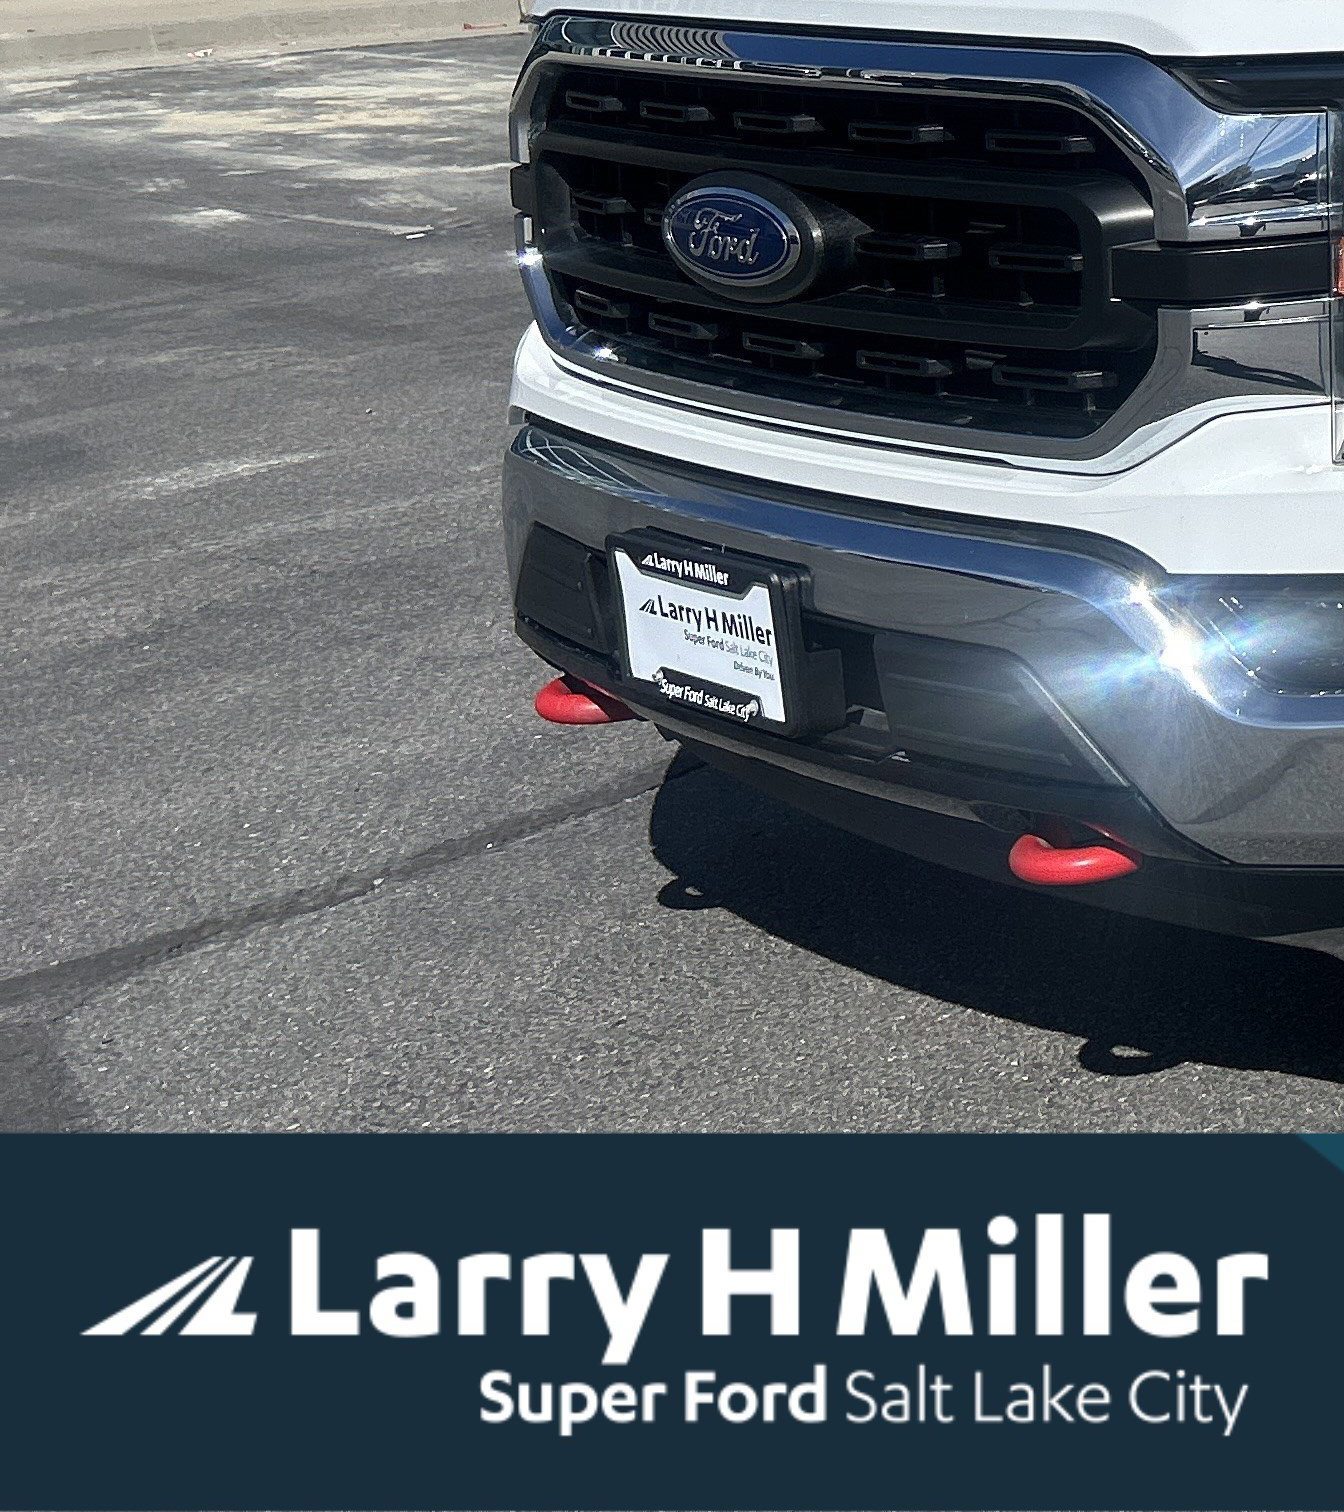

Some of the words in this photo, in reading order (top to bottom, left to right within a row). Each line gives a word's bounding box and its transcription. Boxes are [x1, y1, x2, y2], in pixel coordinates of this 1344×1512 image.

[689, 207, 760, 265] Ford
[653, 552, 683, 578] Larry
[683, 560, 694, 577] H
[694, 563, 729, 586] Miller
[657, 594, 702, 632] Larry
[704, 606, 719, 632] H
[721, 612, 772, 646] Miller
[684, 629, 706, 645] Super
[706, 636, 725, 650] Ford
[725, 641, 738, 655] Salt
[741, 647, 757, 660] Lake
[758, 650, 773, 666] City
[660, 679, 685, 699] Super
[684, 686, 704, 705] Ford
[704, 694, 719, 709] Salt
[719, 699, 736, 714] Lake
[736, 704, 751, 722] City
